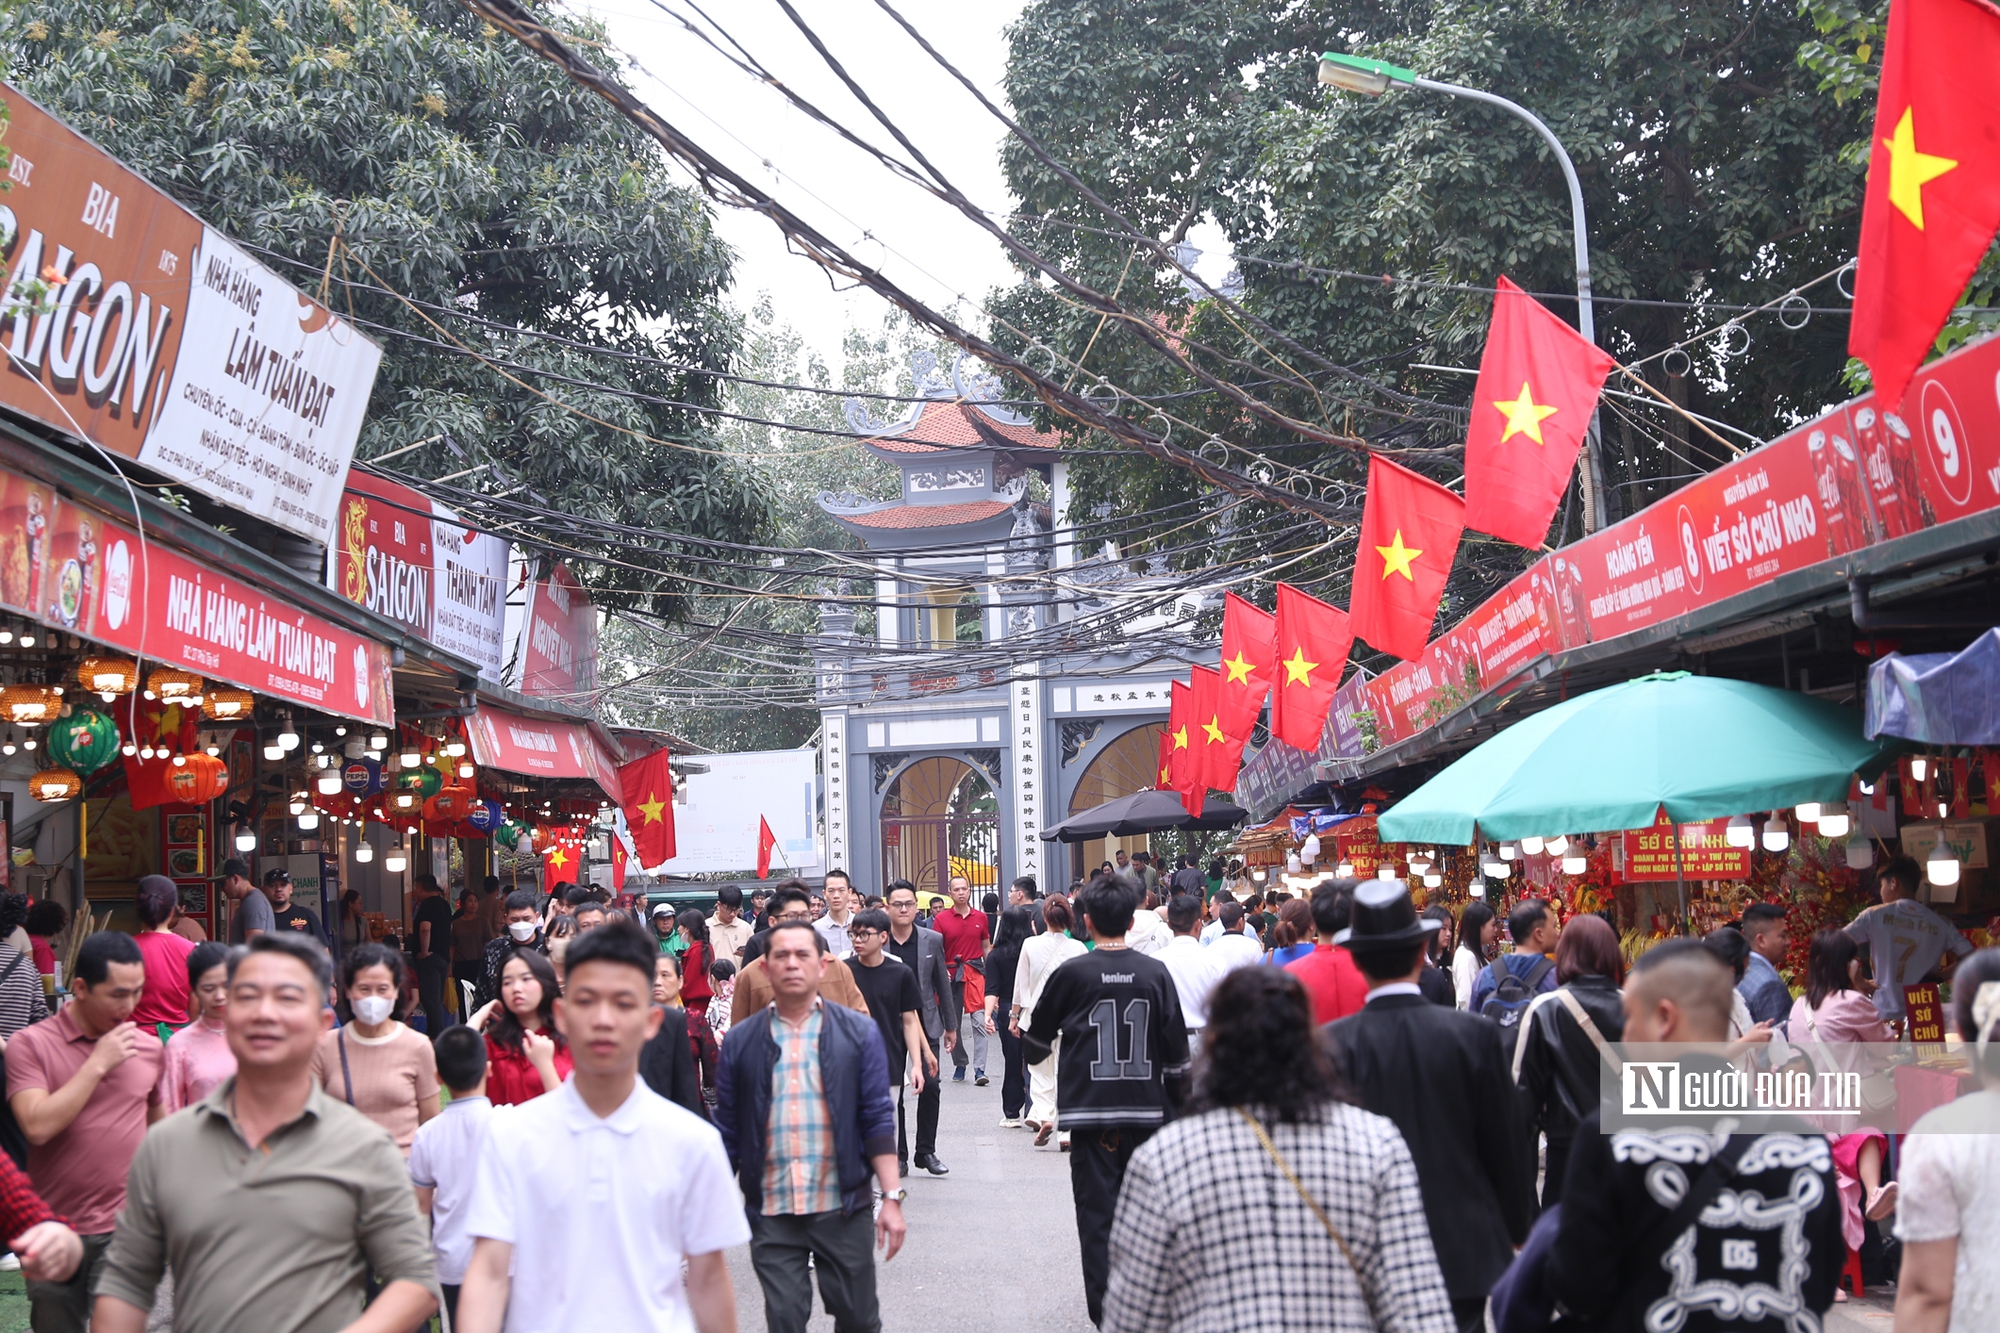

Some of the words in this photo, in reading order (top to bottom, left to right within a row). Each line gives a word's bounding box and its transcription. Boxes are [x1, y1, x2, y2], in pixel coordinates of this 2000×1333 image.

[9, 154, 33, 187] EST.
[81, 181, 120, 239] BIA
[158, 249, 179, 276] 1875
[204, 255, 232, 297] NHÀ
[228, 269, 262, 316] HÀNG
[225, 321, 266, 390] LÂM
[262, 349, 307, 413] TUẤN
[301, 375, 335, 438] ĐẠT
[228, 408, 244, 429] CUA
[1933, 408, 1960, 478] 9
[394, 521, 406, 546] BIA
[435, 524, 448, 550] NHÀ
[447, 527, 461, 556] HÀNG
[1682, 522, 1699, 577] 8
[1702, 514, 1734, 574] VIẾT
[1731, 510, 1752, 564] SỚ
[1751, 499, 1783, 557] CHỮ
[1779, 494, 1817, 545] NHO
[1605, 539, 1638, 580] HOÀNG
[1634, 523, 1655, 568] YẾN
[366, 544, 428, 629] SAIGON
[446, 559, 476, 610] THANH
[479, 566, 497, 618] TÂM
[166, 573, 202, 638] NHÀ
[204, 583, 247, 653] HÀNG
[246, 601, 277, 664] LÂM
[279, 615, 312, 676] TUẤN
[314, 635, 337, 692] ĐẠT
[1348, 840, 1377, 854] VIẾT
[1639, 832, 1660, 850] SỚ
[1350, 856, 1371, 868] HỮ
[1633, 865, 1652, 875] CHỌN
[1652, 863, 1669, 873] NGÀY
[1658, 854, 1669, 862] PHI
[1671, 853, 1684, 862] CU
[292, 877, 319, 889] CHANH
[1894, 935, 1917, 984] 7
[1908, 987, 1933, 1005] VIẾT
[1915, 1006, 1932, 1023] SỚ
[1088, 998, 1152, 1081] 11
[1914, 1022, 1939, 1041] CHỮ
